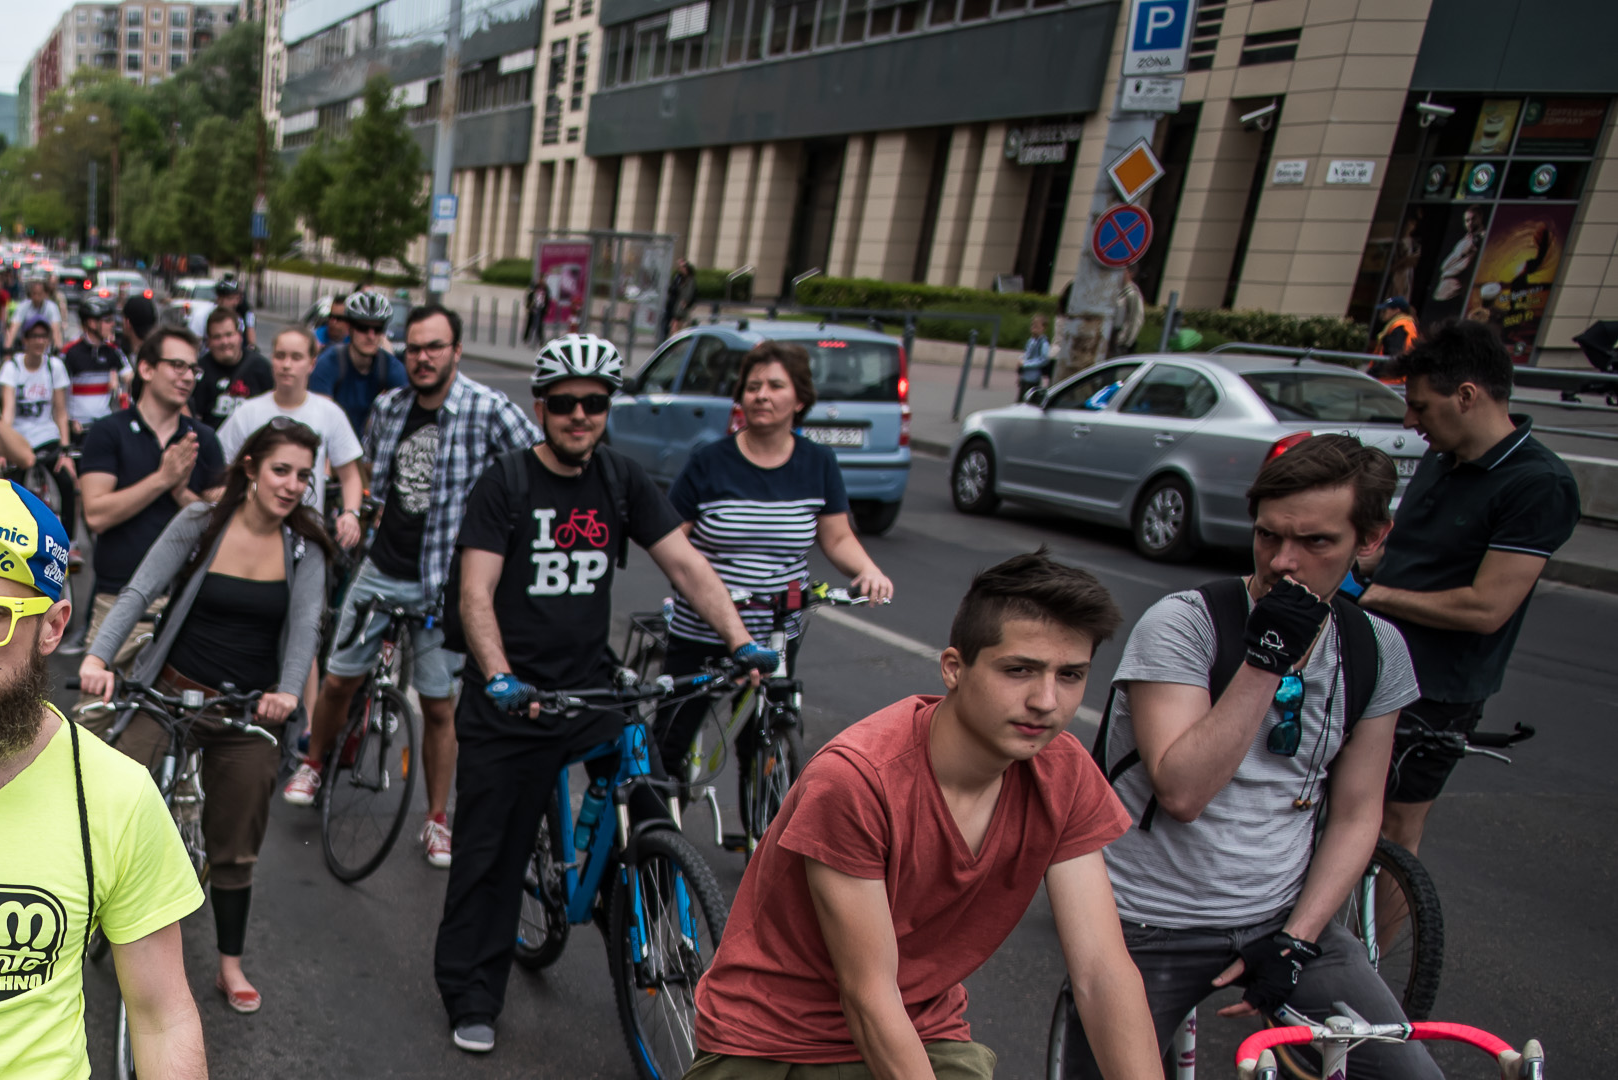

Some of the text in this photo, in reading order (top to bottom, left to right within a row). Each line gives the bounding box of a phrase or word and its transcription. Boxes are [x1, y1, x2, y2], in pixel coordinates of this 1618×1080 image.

[1145, 6, 1175, 44] P
[532, 508, 557, 549] I
[526, 551, 609, 595] BP
